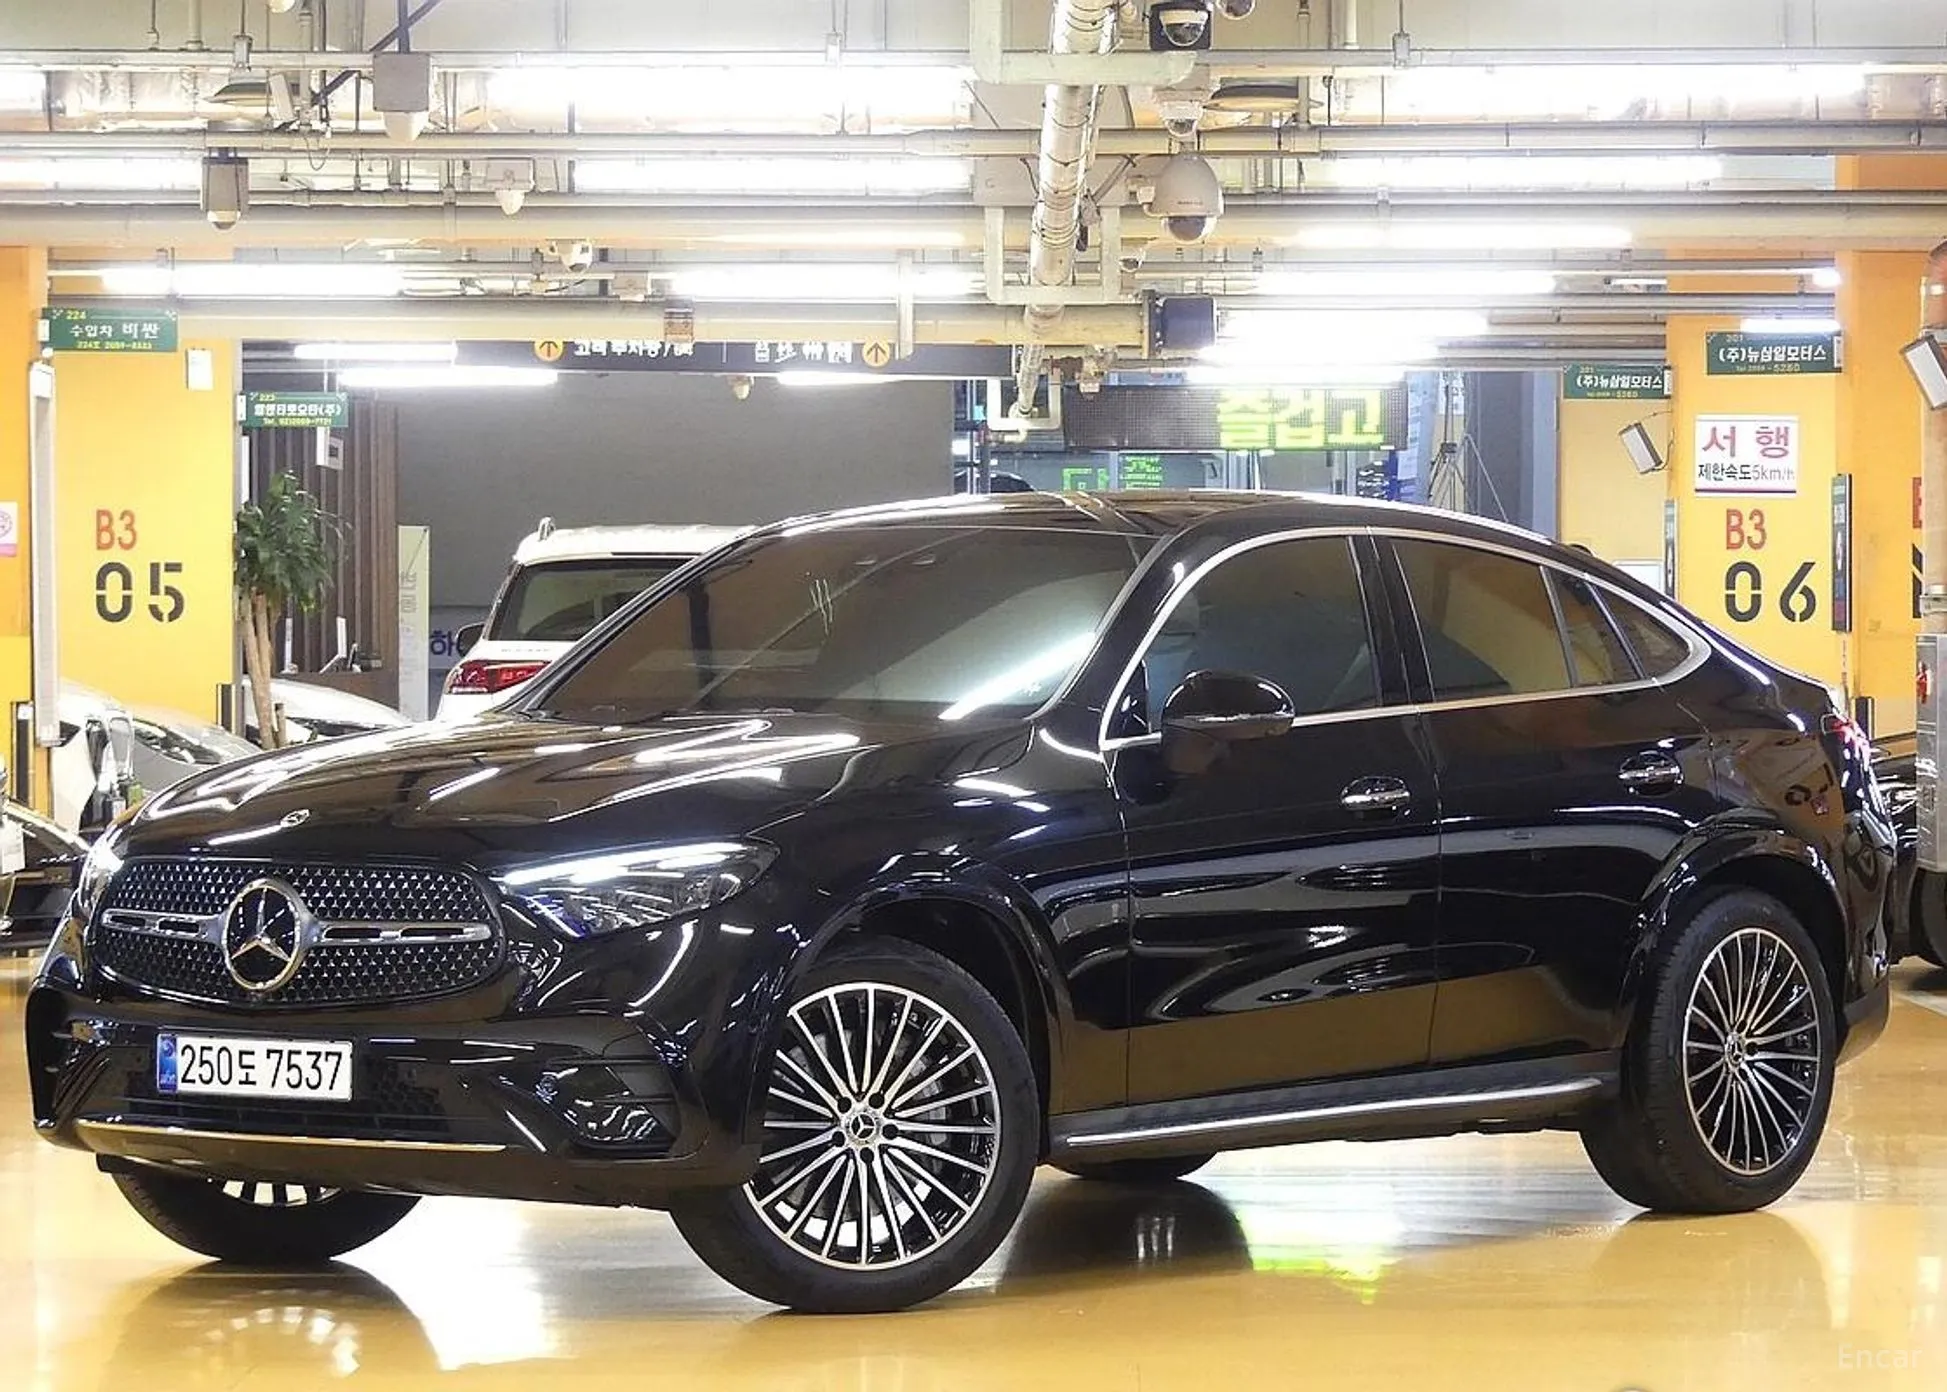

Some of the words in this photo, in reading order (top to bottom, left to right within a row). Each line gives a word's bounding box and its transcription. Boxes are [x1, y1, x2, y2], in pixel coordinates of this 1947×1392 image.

[66, 309, 87, 320] 224
[96, 508, 137, 551] B3
[1726, 508, 1767, 550] B3
[96, 561, 185, 623] 05
[1725, 560, 1817, 623] 06
[266, 1048, 343, 1091] 7537
